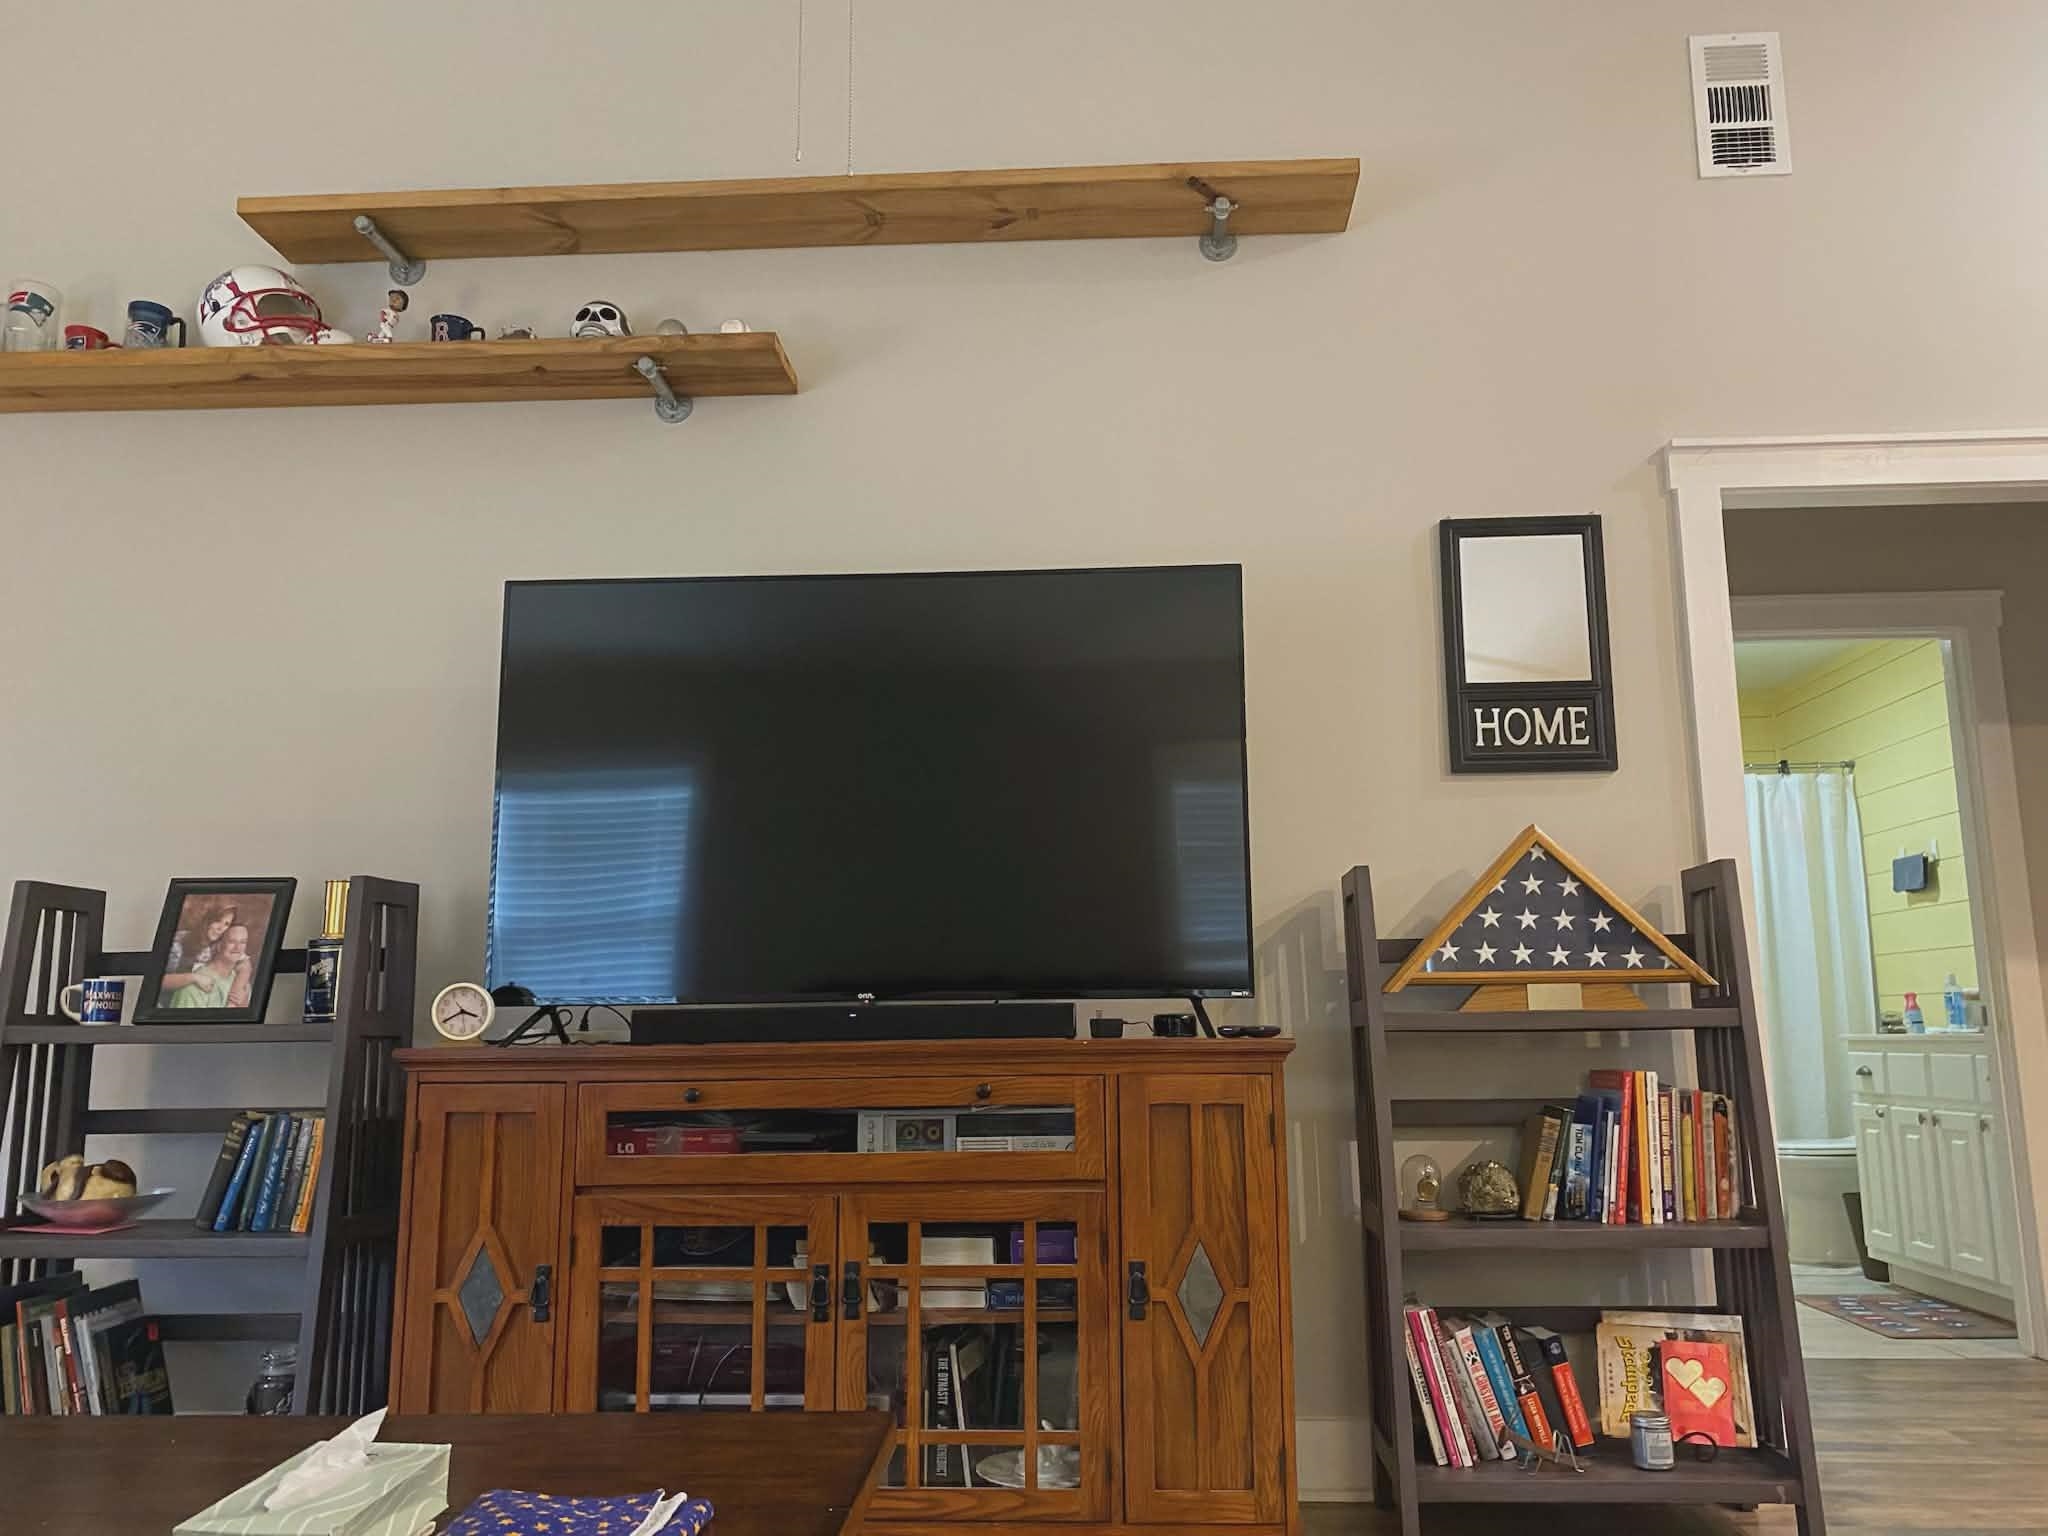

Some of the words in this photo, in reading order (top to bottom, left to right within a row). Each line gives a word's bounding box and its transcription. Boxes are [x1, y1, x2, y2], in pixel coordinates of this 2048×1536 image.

[1473, 706, 1590, 747] HOME
[1575, 1128, 1584, 1144] TOM
[616, 1142, 635, 1153] LG
[937, 1358, 949, 1371] THE
[937, 1372, 949, 1406] DYNASTY
